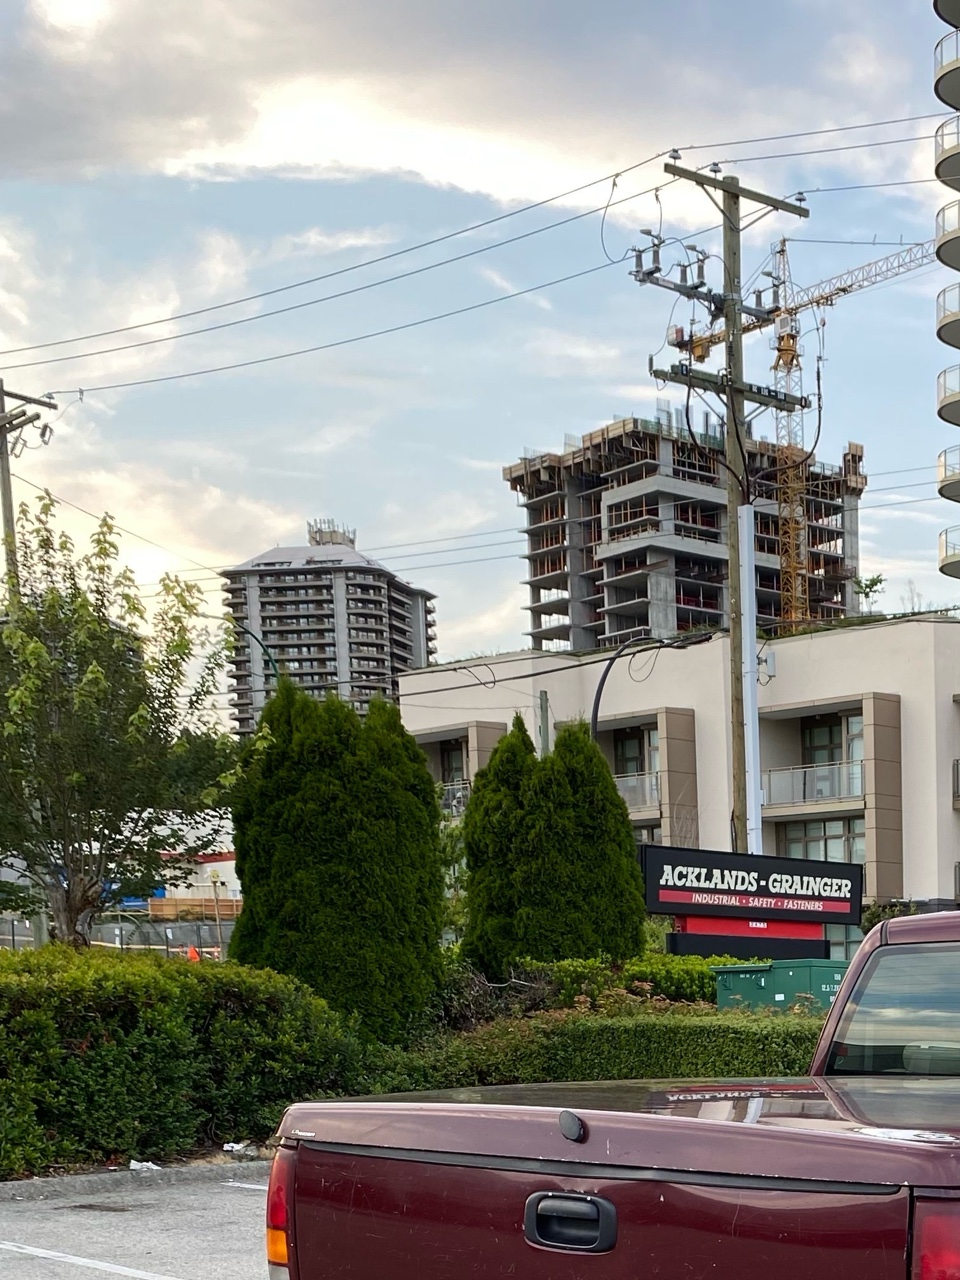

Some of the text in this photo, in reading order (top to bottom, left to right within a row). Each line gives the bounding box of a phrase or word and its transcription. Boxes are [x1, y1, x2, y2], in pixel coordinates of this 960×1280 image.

[692, 893, 823, 911] INDUSTRIAL SAFETY FASTENERS
